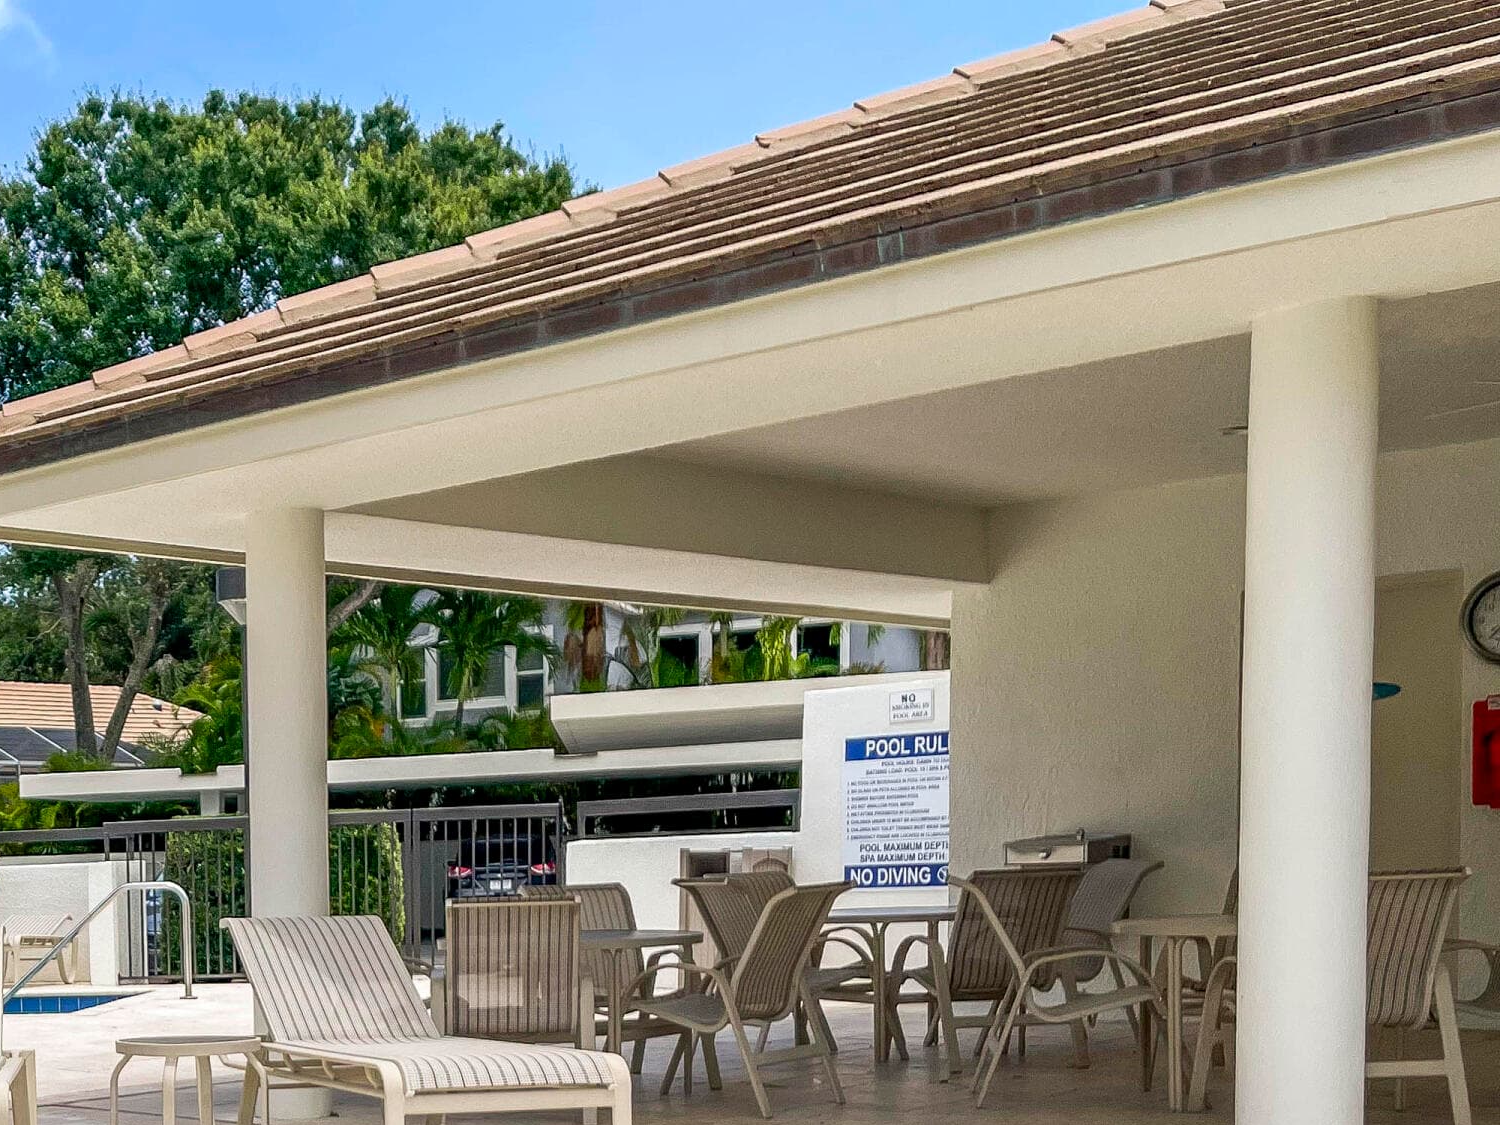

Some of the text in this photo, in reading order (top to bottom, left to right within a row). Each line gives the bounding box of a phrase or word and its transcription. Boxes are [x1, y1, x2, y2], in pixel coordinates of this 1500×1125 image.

[901, 693, 916, 703] NO
[865, 738, 911, 757] POOL
[860, 843, 882, 853] POOL
[884, 841, 922, 851] MAXIMUM
[860, 854, 876, 863] SPA
[877, 852, 916, 862] MAXIMUM
[850, 866, 931, 886] NO DIVING
